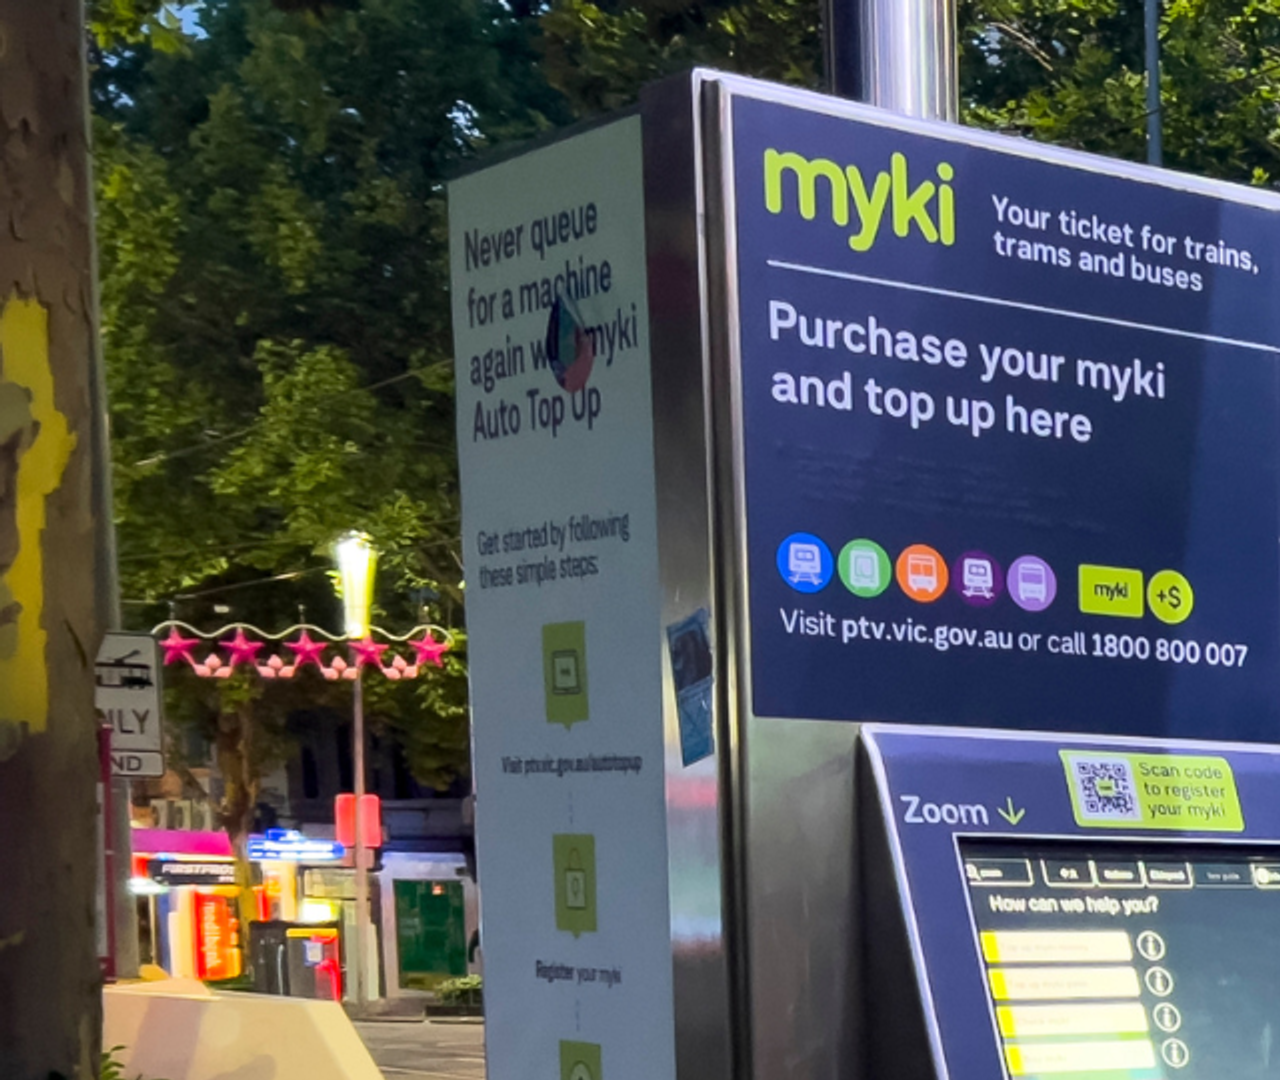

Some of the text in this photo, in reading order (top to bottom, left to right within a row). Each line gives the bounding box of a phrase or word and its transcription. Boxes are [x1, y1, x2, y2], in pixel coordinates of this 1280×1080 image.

[763, 147, 955, 251] myki
[464, 202, 597, 272] Never queue
[992, 194, 1259, 275] Your ticket for trains,
[993, 231, 1203, 291] trams and buses
[468, 255, 612, 329] for a machine
[470, 334, 525, 393] again
[769, 300, 1165, 402] Purchase your myki
[473, 384, 601, 443] Auto Top Up
[771, 369, 1092, 442] and top up here
[477, 512, 630, 556] Get started by following
[479, 563, 514, 589] these
[516, 555, 557, 587] simple
[1094, 580, 1129, 601] myki
[780, 607, 1248, 668] Visit ptv.vic.gov.au or call 1800 800 007
[110, 755, 142, 771] ND
[1138, 761, 1223, 780] Scan code
[1144, 782, 1226, 802] to register
[900, 795, 989, 825] Zoom
[1147, 801, 1226, 819] your myki
[989, 895, 1159, 916] How can we help you?
